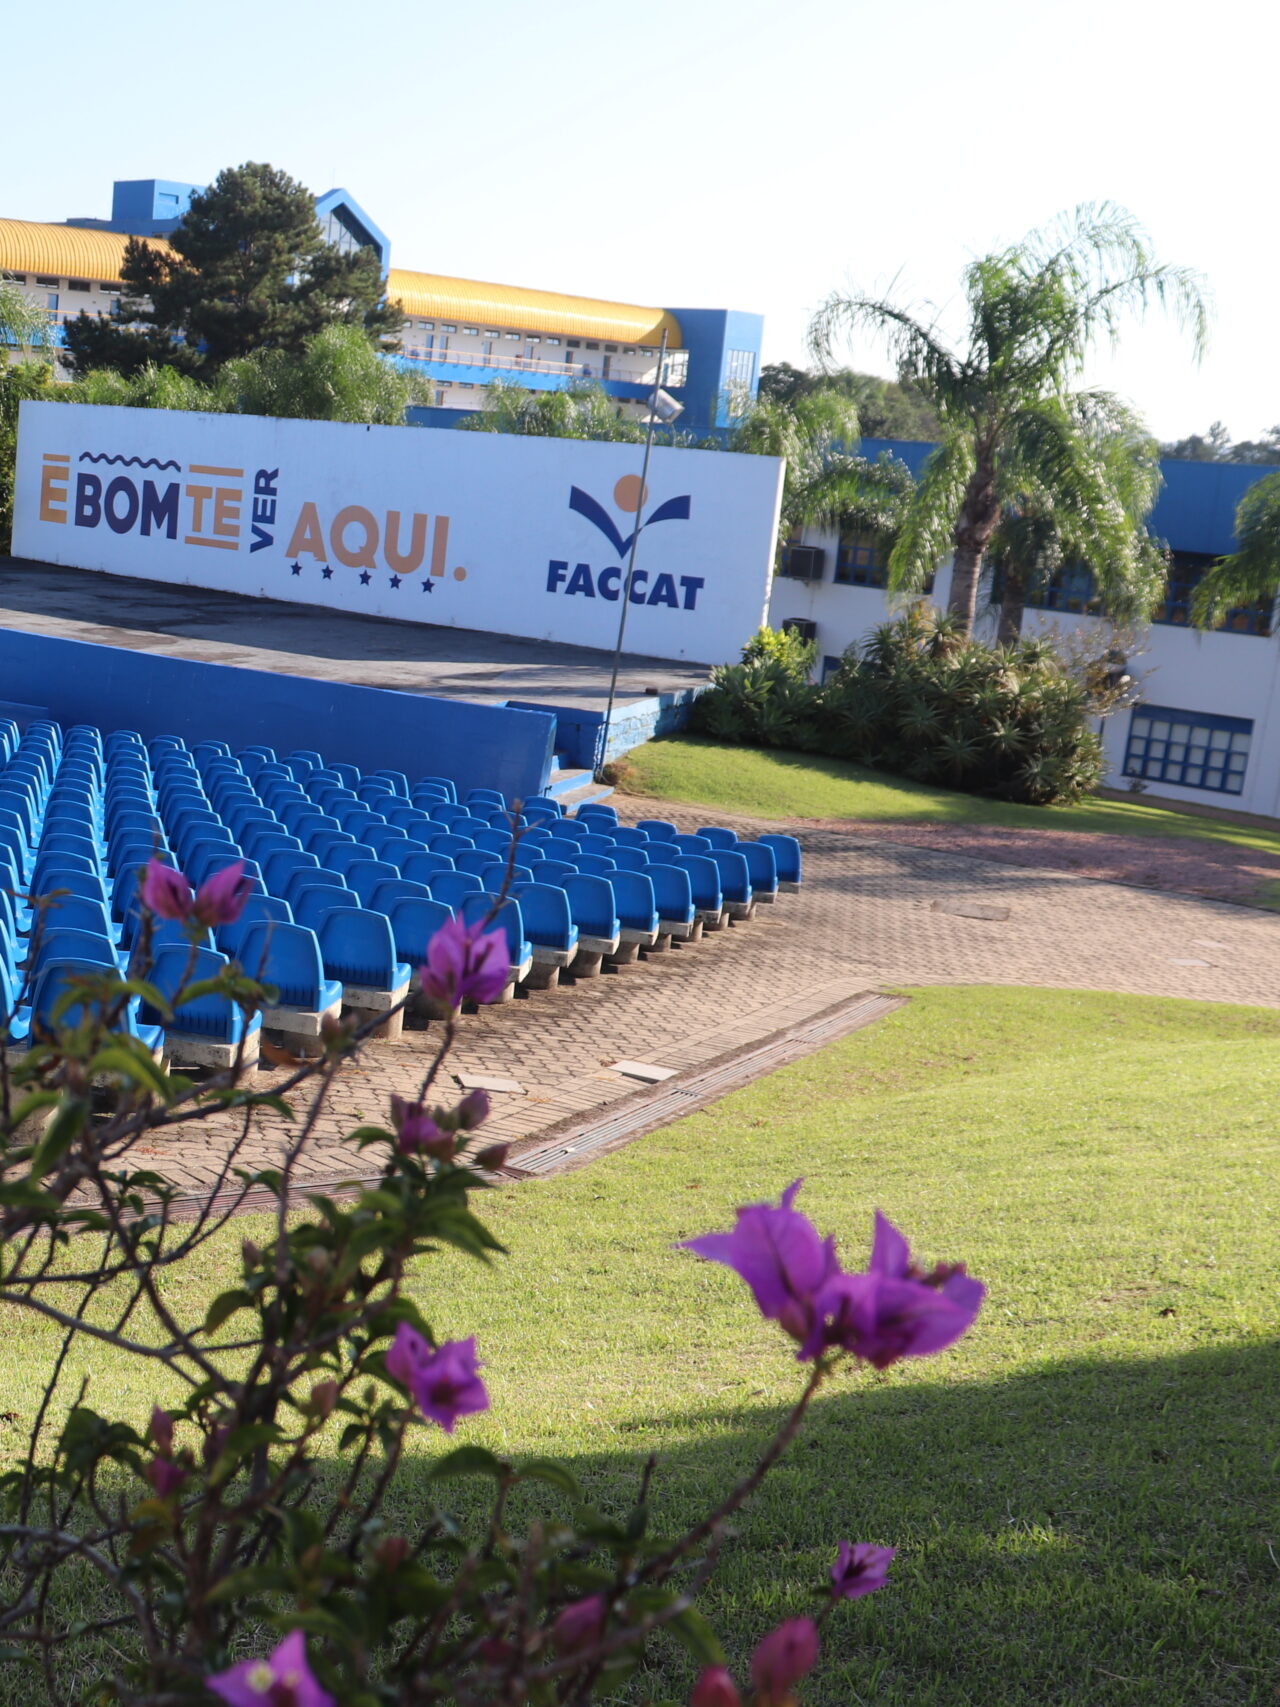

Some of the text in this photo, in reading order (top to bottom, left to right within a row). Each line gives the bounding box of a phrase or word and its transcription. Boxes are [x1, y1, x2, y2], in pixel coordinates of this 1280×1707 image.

[74, 472, 181, 540] BOM
[186, 484, 243, 537] TE
[249, 467, 279, 554] VER
[285, 502, 467, 581] AQUI.
[546, 559, 705, 611] FACCAT
